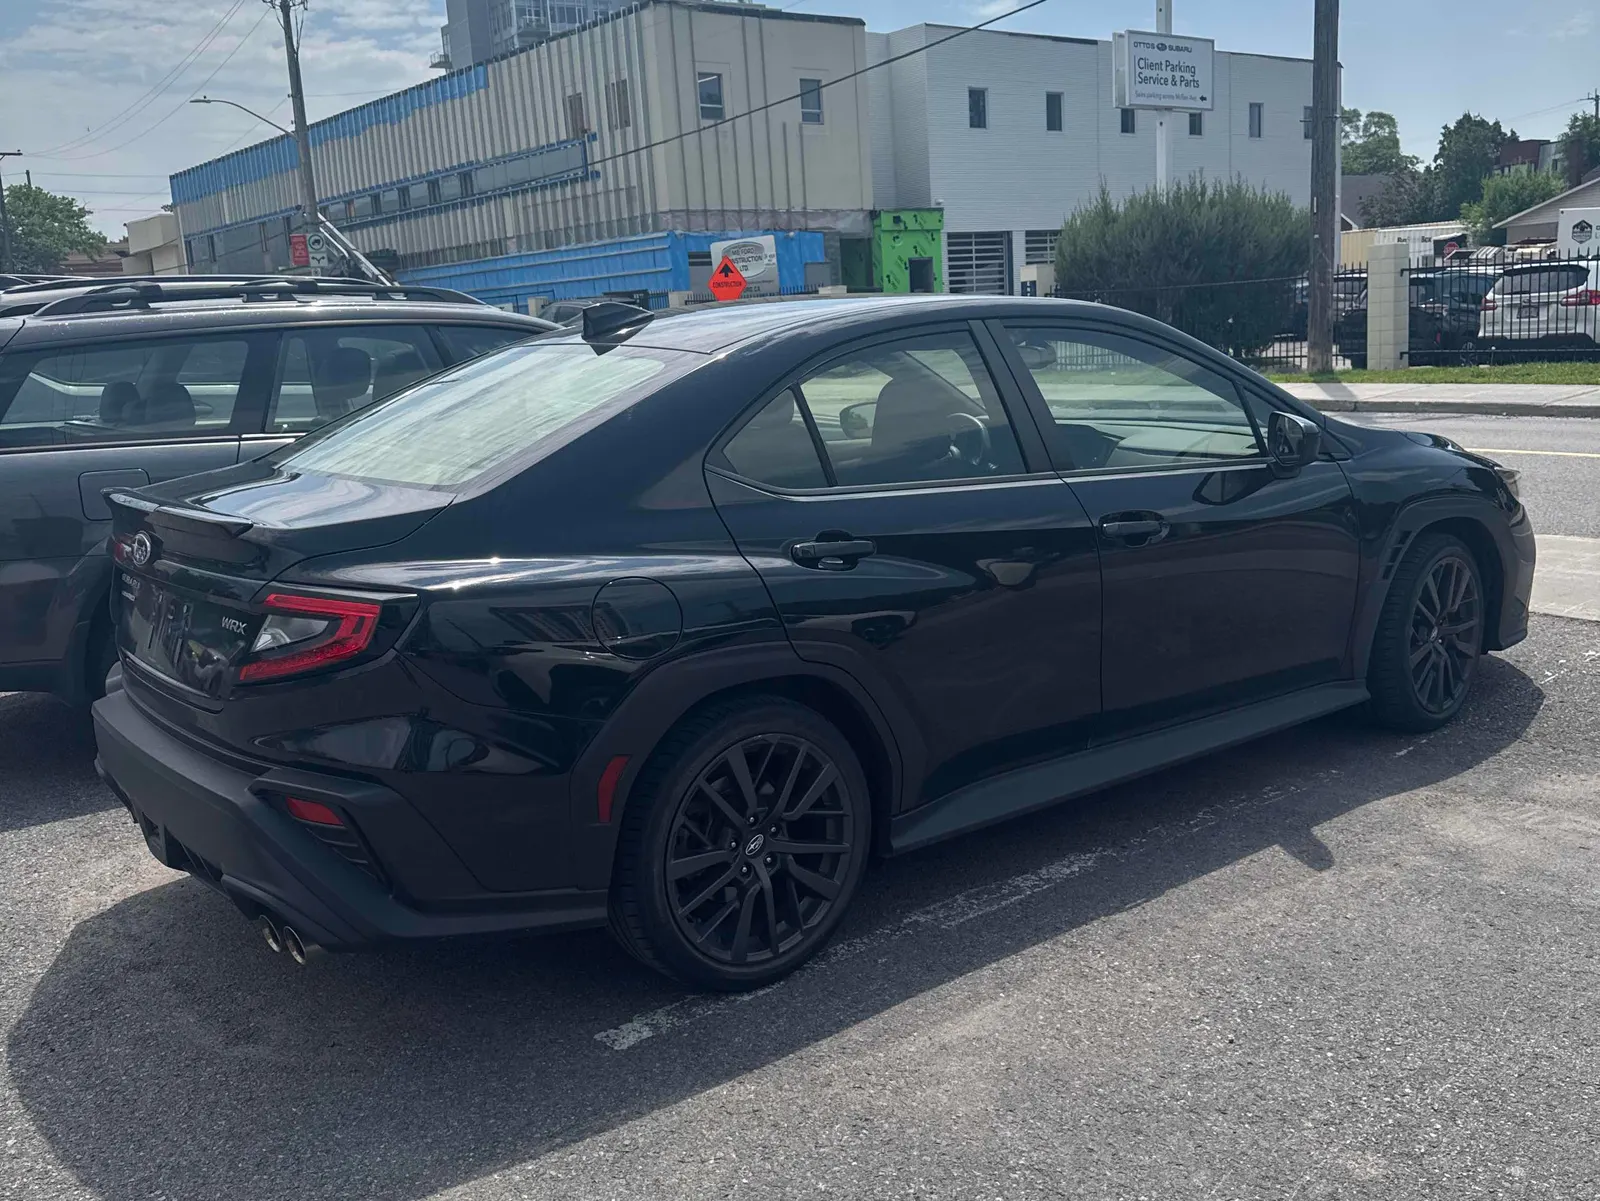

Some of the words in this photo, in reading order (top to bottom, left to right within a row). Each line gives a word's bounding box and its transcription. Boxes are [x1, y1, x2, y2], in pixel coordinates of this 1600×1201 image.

[1168, 44, 1192, 53] SUBARU
[1137, 57, 1163, 71] Client
[1165, 60, 1196, 77] Parking
[1138, 72, 1168, 86] Service
[1171, 74, 1178, 87] &
[1180, 75, 1200, 88] Parts
[731, 255, 763, 264] NSTRUCTION
[221, 616, 247, 635] WRX
